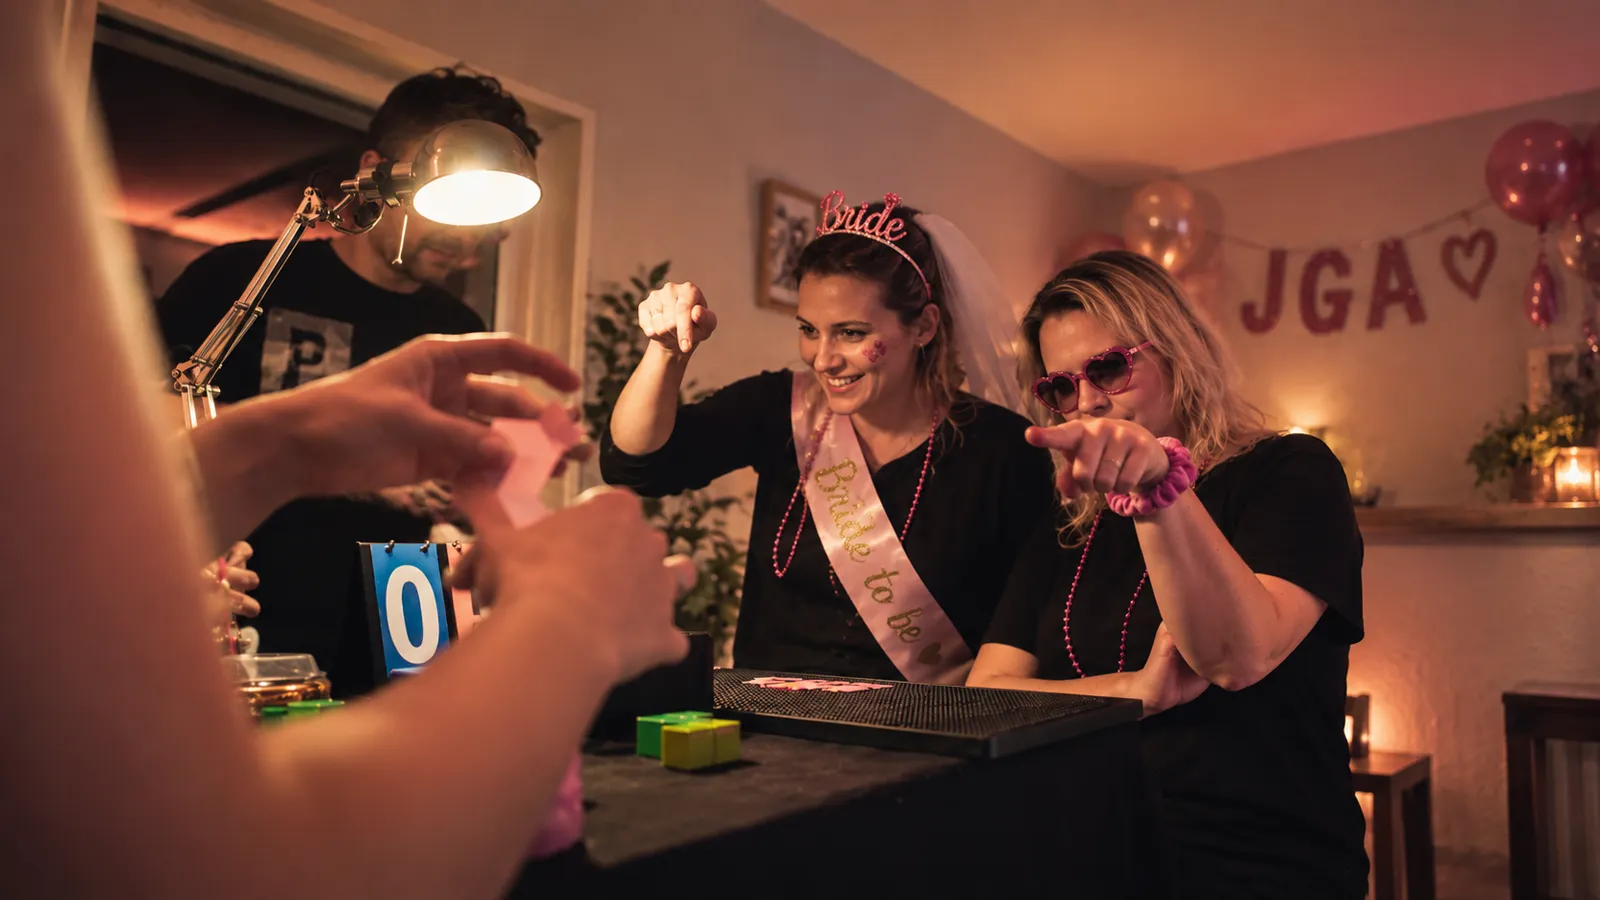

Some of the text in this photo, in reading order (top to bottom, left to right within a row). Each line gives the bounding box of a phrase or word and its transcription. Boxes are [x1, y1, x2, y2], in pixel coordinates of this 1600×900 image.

[816, 189, 908, 242] Bride
[1240, 237, 1427, 336] JGA
[281, 326, 326, 389] P
[814, 456, 924, 644] Bride to be
[386, 564, 441, 665] 0
